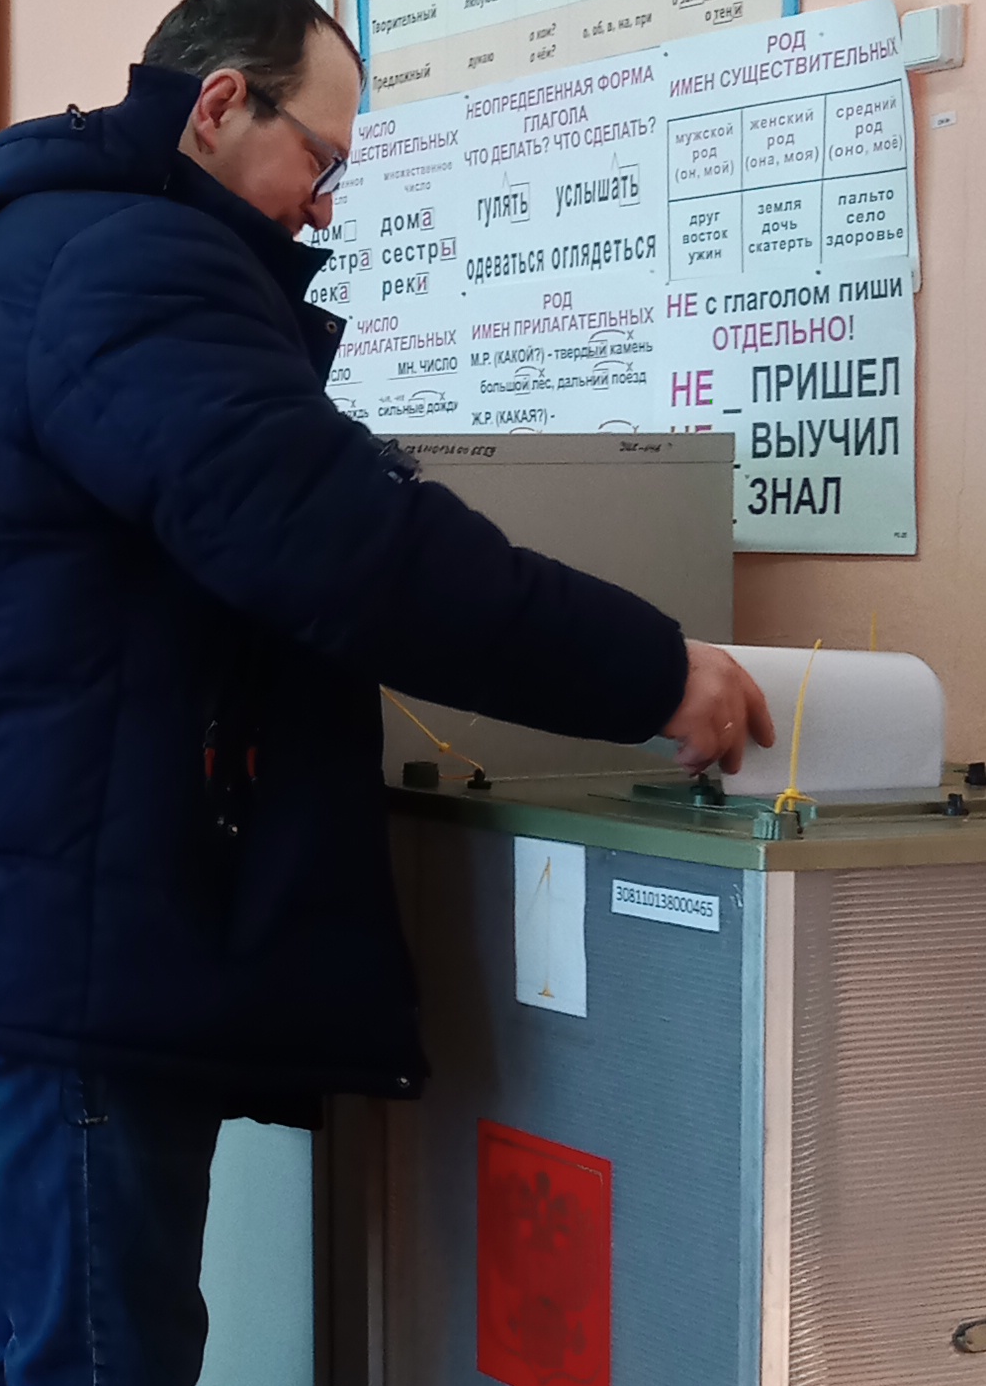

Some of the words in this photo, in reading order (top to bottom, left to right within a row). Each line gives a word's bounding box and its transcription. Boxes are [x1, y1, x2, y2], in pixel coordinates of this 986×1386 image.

[372, 4, 437, 35] Творительный
[767, 30, 806, 53] РОД
[373, 62, 431, 93] Предложный
[670, 73, 714, 98] ИМЕН
[720, 37, 898, 88] СУЩЕСТВИТЕЛЬНЫХ
[466, 77, 593, 120] НЕОПРЕДЕЛЕННАЯ
[597, 65, 654, 91] ФОРМА
[524, 105, 589, 133] ГЛАГОЛА
[750, 110, 814, 130] женский
[836, 96, 897, 120] средний
[358, 120, 396, 140] ЧИСЛО
[465, 148, 488, 167] ЧТО
[491, 137, 550, 165] ДЕЛАТЬ?
[554, 131, 580, 150] ЧТО
[585, 116, 657, 147] СДЕЛАТЬ?
[675, 123, 734, 147] мужской
[767, 132, 795, 150] род
[855, 121, 883, 139] род
[350, 130, 459, 164] ЩЕСТВИТЕЛЬНЫХ
[692, 146, 718, 163] род
[828, 144, 869, 162] (оно,
[383, 161, 453, 181] множественное
[745, 155, 780, 172] (она,
[784, 147, 819, 164] моя)
[675, 168, 701, 184] (он,
[704, 161, 735, 179] мой)
[556, 171, 640, 217] услышать
[838, 188, 894, 206] пальто
[477, 188, 529, 228] гулять
[757, 199, 802, 215] земля
[846, 209, 886, 225] село
[380, 207, 435, 237] дома
[689, 211, 720, 228] друг
[762, 220, 797, 235] дочь
[682, 230, 728, 245] восток
[748, 236, 813, 255] скатерть
[826, 227, 904, 247] здоровье
[382, 237, 456, 264] сестры
[466, 249, 545, 284] одеваться
[551, 234, 657, 271] оглядеться
[688, 248, 722, 265] ужин
[382, 272, 429, 301] реки
[667, 292, 698, 319] НЕ
[705, 296, 717, 315] с
[724, 284, 830, 314] глаголом
[839, 277, 903, 303] пиши
[543, 291, 573, 310] РОД
[357, 316, 399, 335] ЧИСЛО
[472, 322, 510, 340] ИМЕН
[514, 307, 655, 336] ПРИЛАГАТЕЛЬНЫХ
[713, 315, 854, 354] ОТДЕЛЬНО!
[338, 330, 457, 359] ПРИЛАГАТЕЛЬНЫХ
[470, 352, 492, 367] М.Р.
[494, 345, 545, 368] (КАКОЙ?)
[554, 343, 608, 362] твердый
[610, 341, 653, 355] камень
[330, 368, 351, 382] СЛО
[420, 356, 458, 372] ЧИСЛО
[480, 376, 530, 394] большой
[531, 378, 555, 391] лес,
[557, 371, 609, 389] дальний
[611, 371, 647, 386] поезд
[671, 370, 714, 407] НЕ
[752, 356, 900, 403] ПРИШЕЛ
[496, 409, 548, 427] (КАКАЯ?)
[751, 416, 899, 460] ВЫУЧИЛ
[747, 476, 842, 515] ЗНАЛ
[616, 886, 714, 917] 308110138000465
